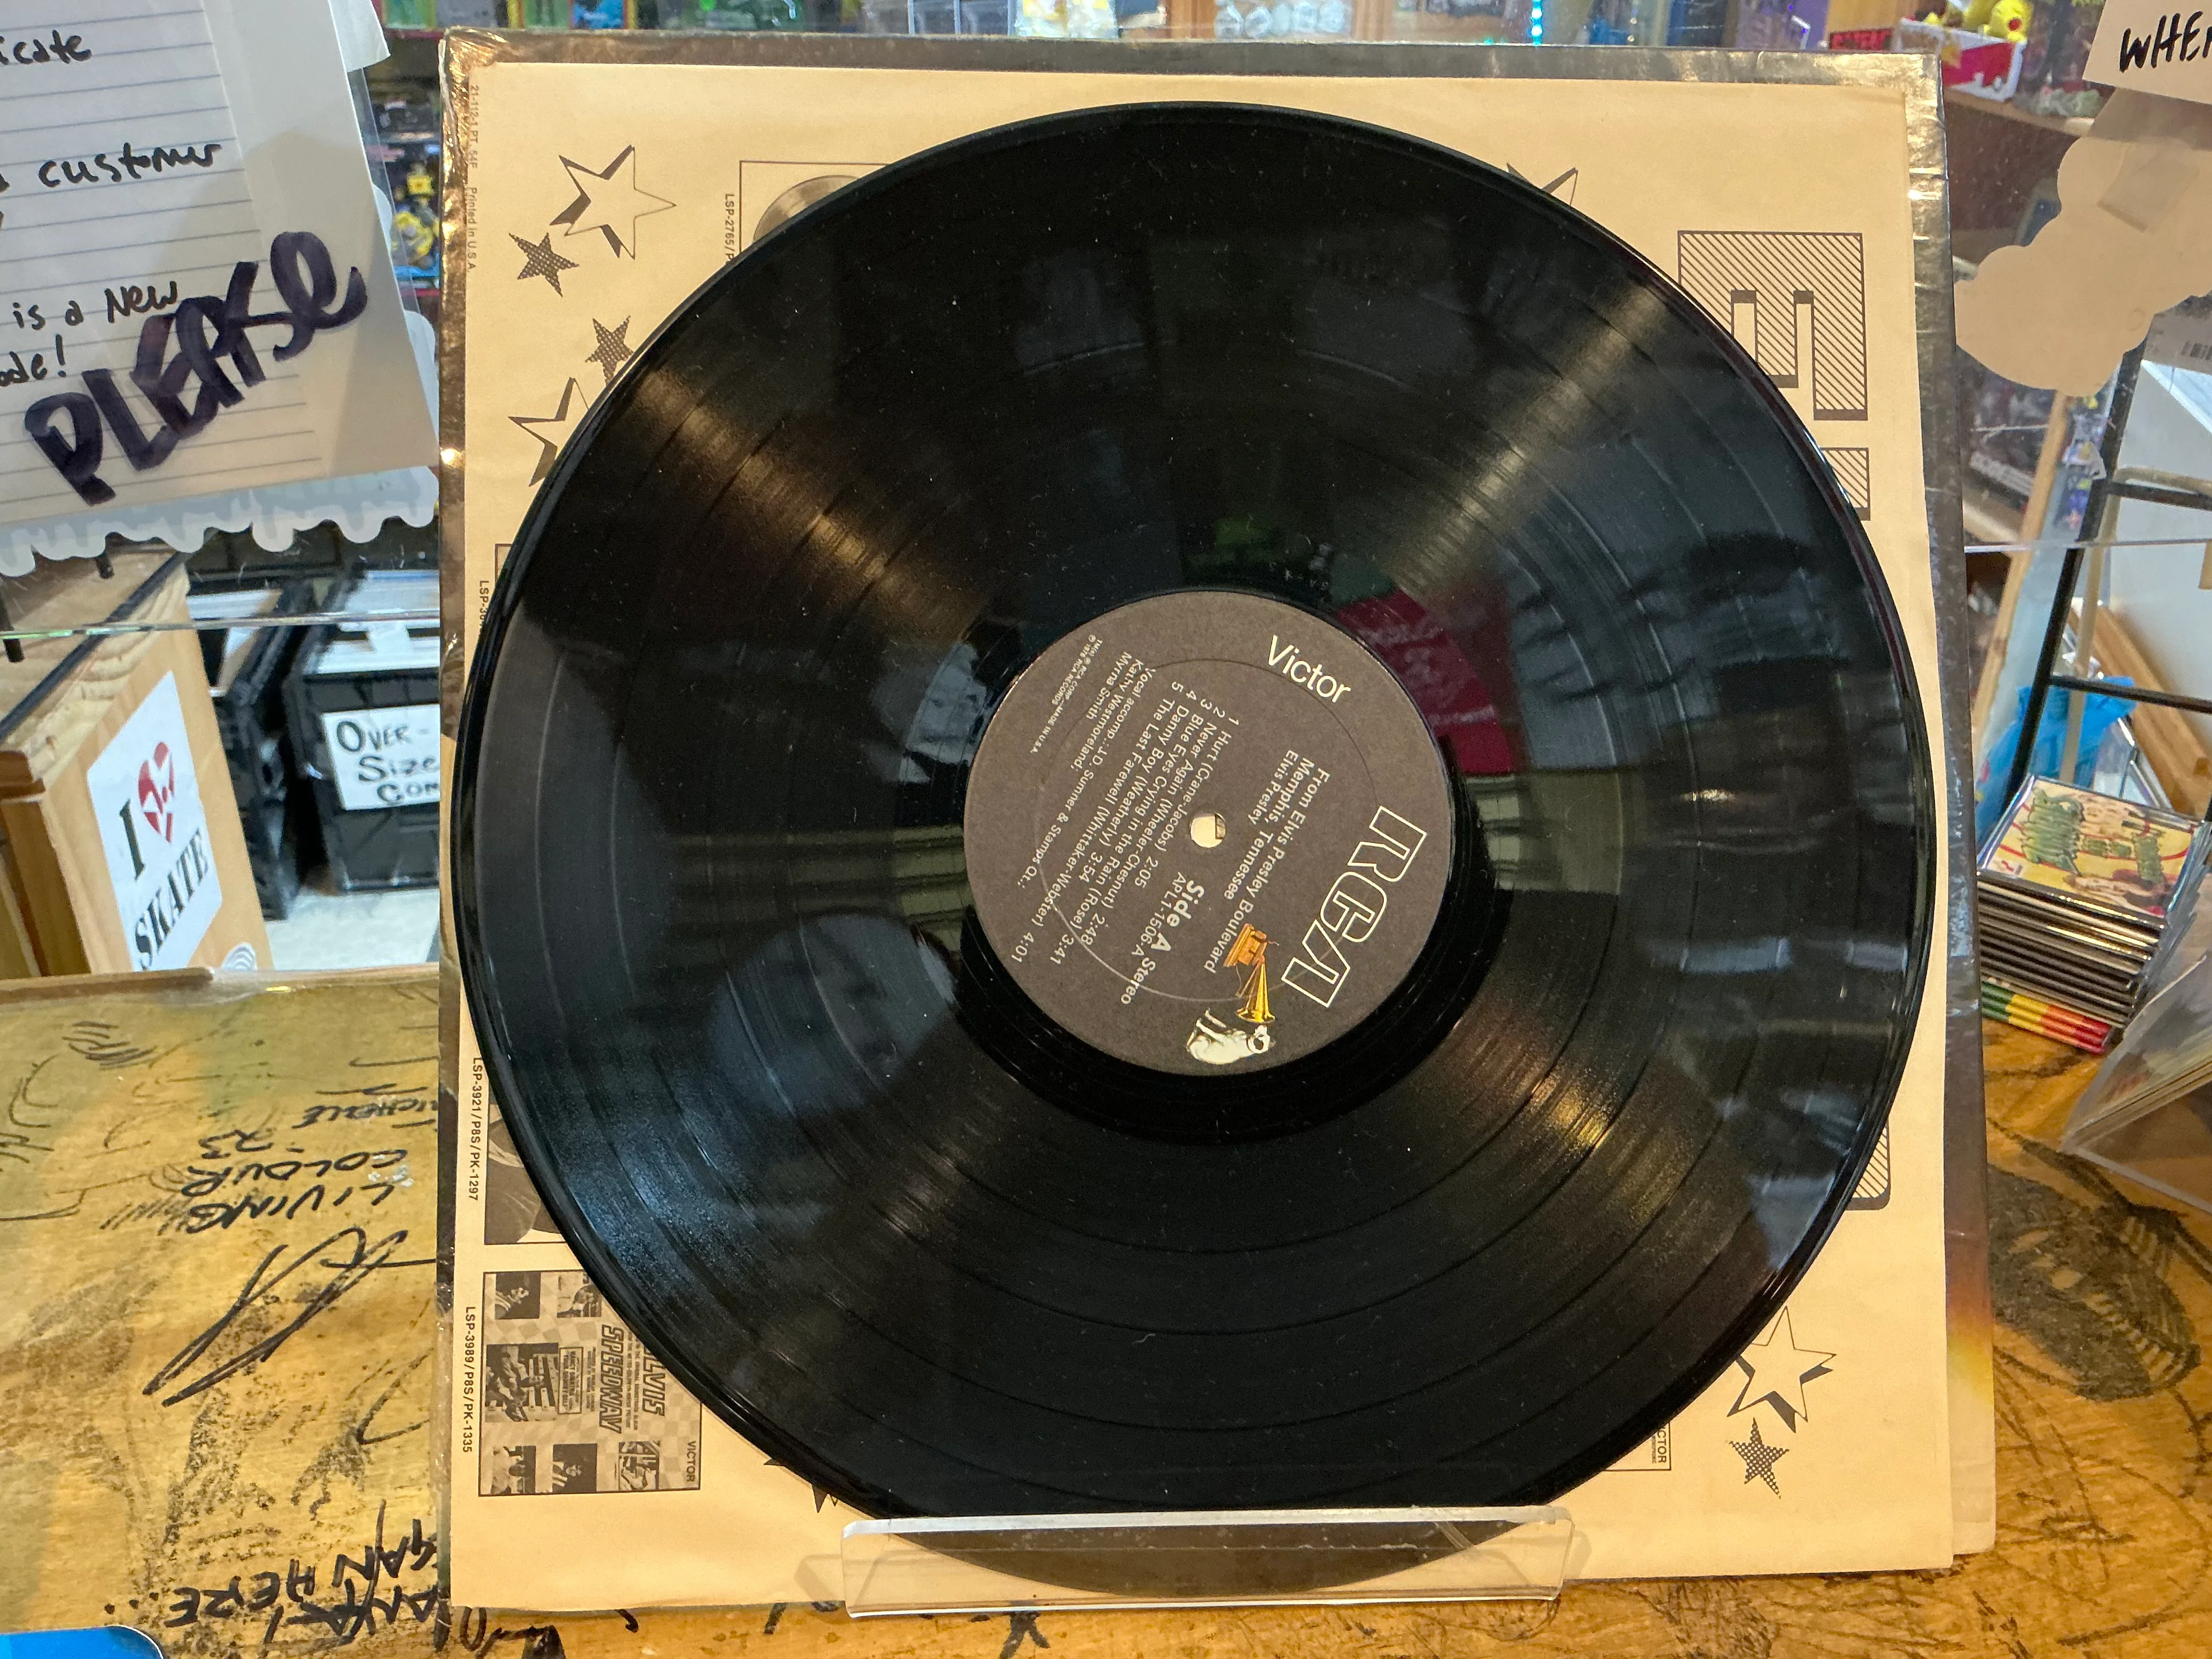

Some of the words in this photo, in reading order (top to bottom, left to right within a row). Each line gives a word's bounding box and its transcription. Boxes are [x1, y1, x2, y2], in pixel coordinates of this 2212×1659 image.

[468, 187, 477, 224] Printed
[468, 228, 477, 238] in
[12, 302, 46, 330] is
[65, 300, 84, 326] a
[1071, 658, 1082, 672] RCA
[1075, 665, 1087, 679] RCA
[1106, 652, 1132, 686] Myrna
[1119, 659, 1144, 692] Kathy
[1132, 668, 1156, 698] Vocal
[1268, 634, 1351, 703] Victor
[1052, 673, 1074, 705] RECORDS
[1086, 687, 1110, 719] Smith
[1172, 682, 1184, 692] 5
[1186, 690, 1197, 700] 4
[1200, 699, 1212, 710] 3
[1154, 698, 1175, 720] The
[1158, 705, 1189, 746] Danny
[1213, 707, 1225, 718] 2
[1042, 726, 1051, 735] IN
[1071, 694, 1124, 771] Westmoreland;
[1136, 723, 1159, 750] Last
[1181, 714, 1204, 742] Blue
[1190, 722, 1217, 758] Never
[1207, 731, 1232, 761] Hurt
[1142, 747, 1164, 774] Boy
[1162, 744, 1186, 773] Eyes
[1274, 750, 1299, 780] Elvis
[1065, 770, 1094, 811] Sumner
[1105, 752, 1142, 804] Farewell
[1167, 759, 1193, 795] Again
[1265, 758, 1314, 823] Memphis,
[1299, 768, 1330, 808] From
[1099, 776, 1148, 846] (Weatherly)
[1134, 776, 1167, 816] Crying
[1154, 763, 1213, 852] (Crane-Jacobs)
[1248, 780, 1281, 825] Presley
[1057, 812, 1068, 822] &
[1128, 817, 1143, 832] in
[1277, 810, 1306, 844] Elvis
[119, 799, 146, 881] I
[1032, 825, 1061, 866] Stamps
[1101, 798, 1173, 909] (Wheeler-Chesnut)
[1115, 833, 1132, 854] the
[1031, 806, 1110, 926] (Whittaker-Webster)
[1079, 852, 1103, 882] 3:54
[1096, 856, 1120, 884] Rain
[1135, 856, 1158, 888] 2:05
[1224, 831, 1274, 899] Tennessee
[1246, 846, 1285, 898] Presley
[134, 828, 210, 970] SKATE
[1067, 888, 1102, 929] (Rose)
[1131, 871, 1186, 956] APL1-1506-A
[1167, 880, 1204, 927] Side
[1281, 805, 1428, 1008] RCA
[1011, 932, 1034, 962] 4:01
[1078, 913, 1105, 945] 2:48
[1151, 933, 1172, 951] A
[1204, 899, 1254, 973] Boulevard
[1050, 934, 1074, 964] 3:41
[1121, 954, 1155, 1004] Stereo
[469, 1057, 483, 1201] LSP-3921/P8S/PK-1297
[182, 1149, 408, 1197] COLOUR
[186, 1182, 395, 1234] LIVING
[462, 1306, 477, 1453] LSP-3989/P8S/PK-1335
[599, 1324, 624, 1435] SPEEDWAY
[642, 1346, 667, 1417] LVIS
[684, 1440, 697, 1482] VICTOR
[1657, 1427, 1667, 1463] CTOR
